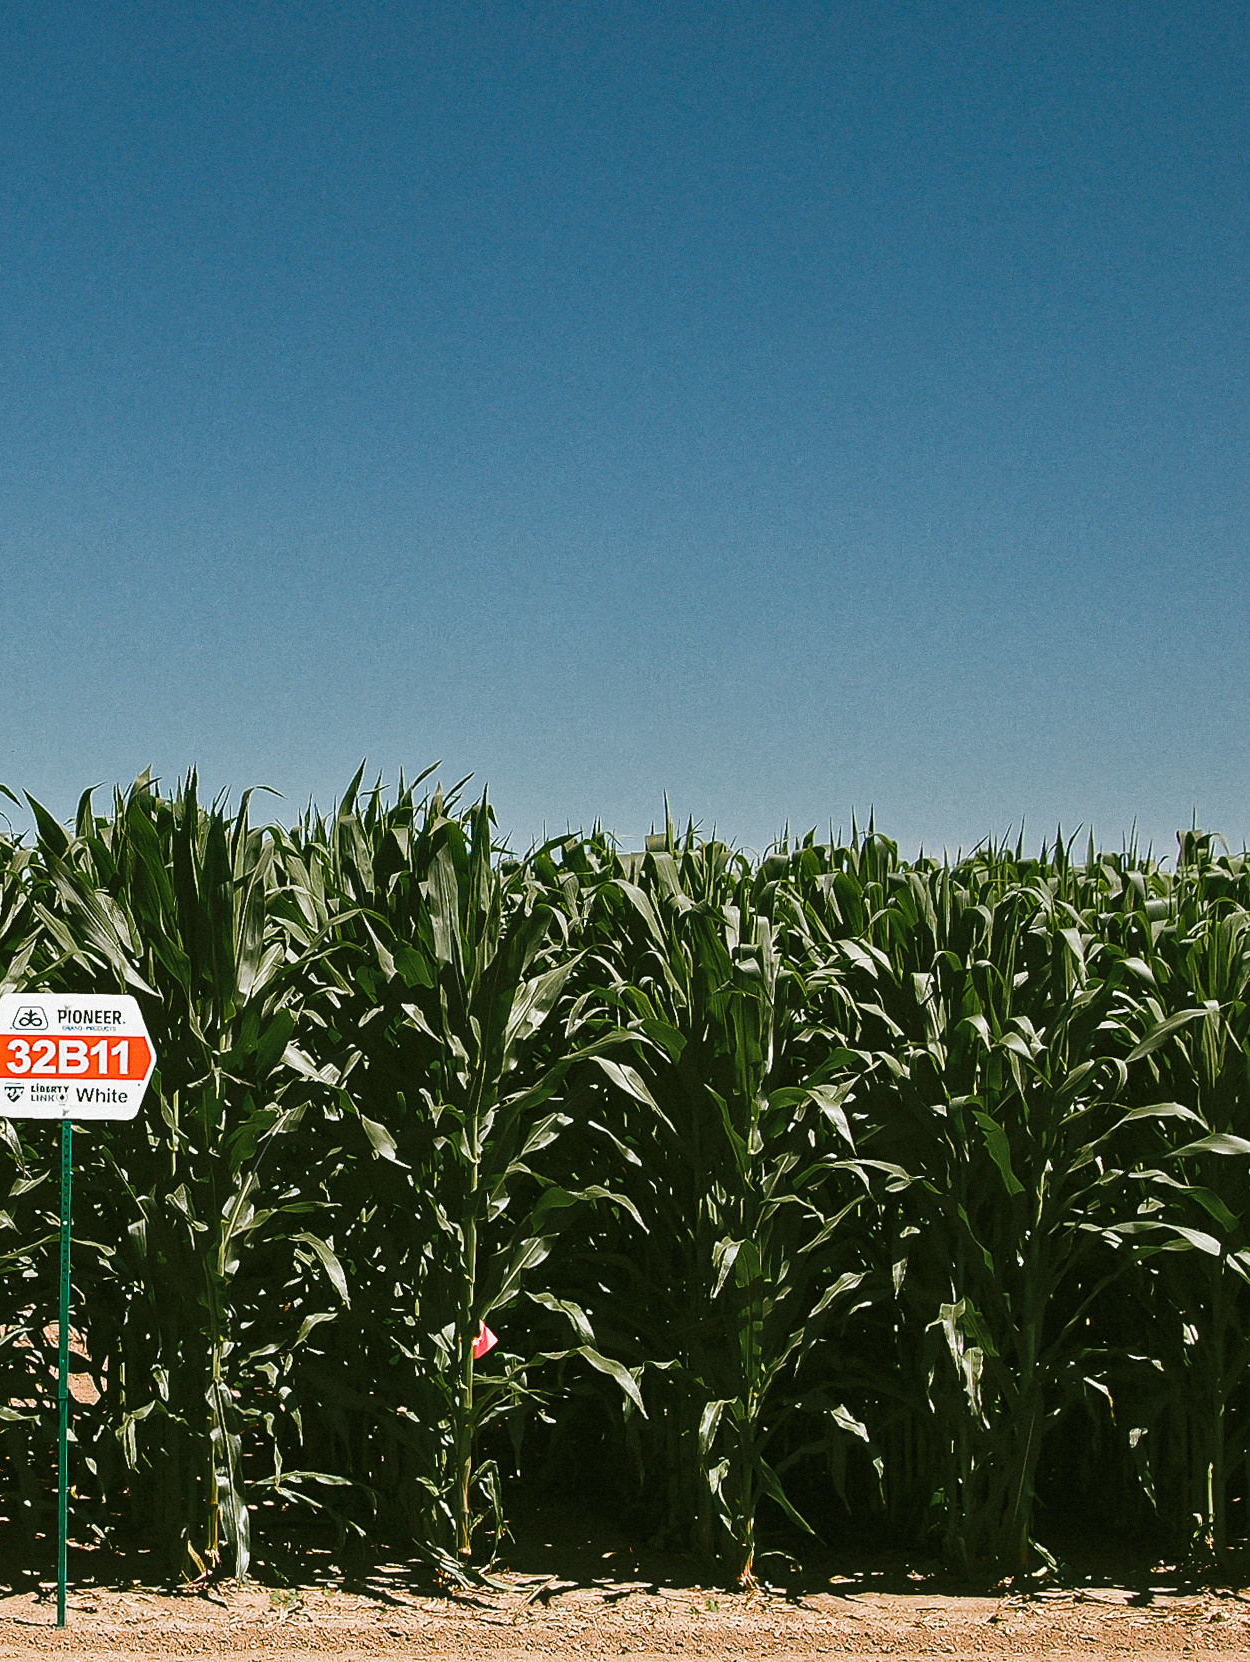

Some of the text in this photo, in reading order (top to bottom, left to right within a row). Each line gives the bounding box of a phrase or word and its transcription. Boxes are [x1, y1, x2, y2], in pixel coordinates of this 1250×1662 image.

[57, 1009, 122, 1025] PIONEER
[6, 1038, 129, 1075] 32B11
[30, 1094, 54, 1102] LINK
[76, 1087, 128, 1103] White
